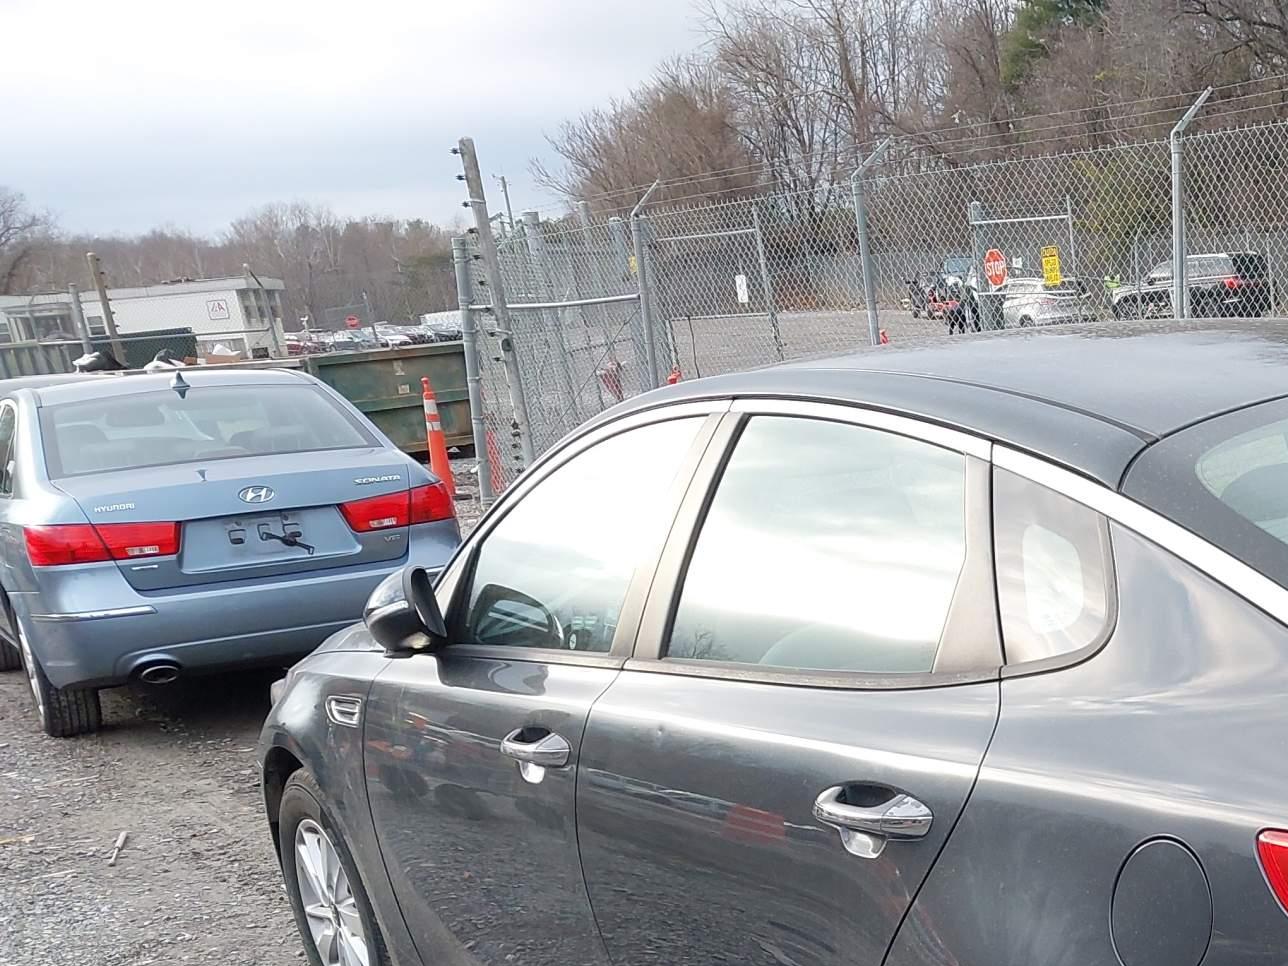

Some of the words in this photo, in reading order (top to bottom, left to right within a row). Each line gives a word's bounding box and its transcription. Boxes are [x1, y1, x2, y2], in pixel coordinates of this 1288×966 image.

[985, 260, 1006, 277] STOP
[354, 474, 401, 486] SONATA
[94, 503, 136, 513] HYUNDAI
